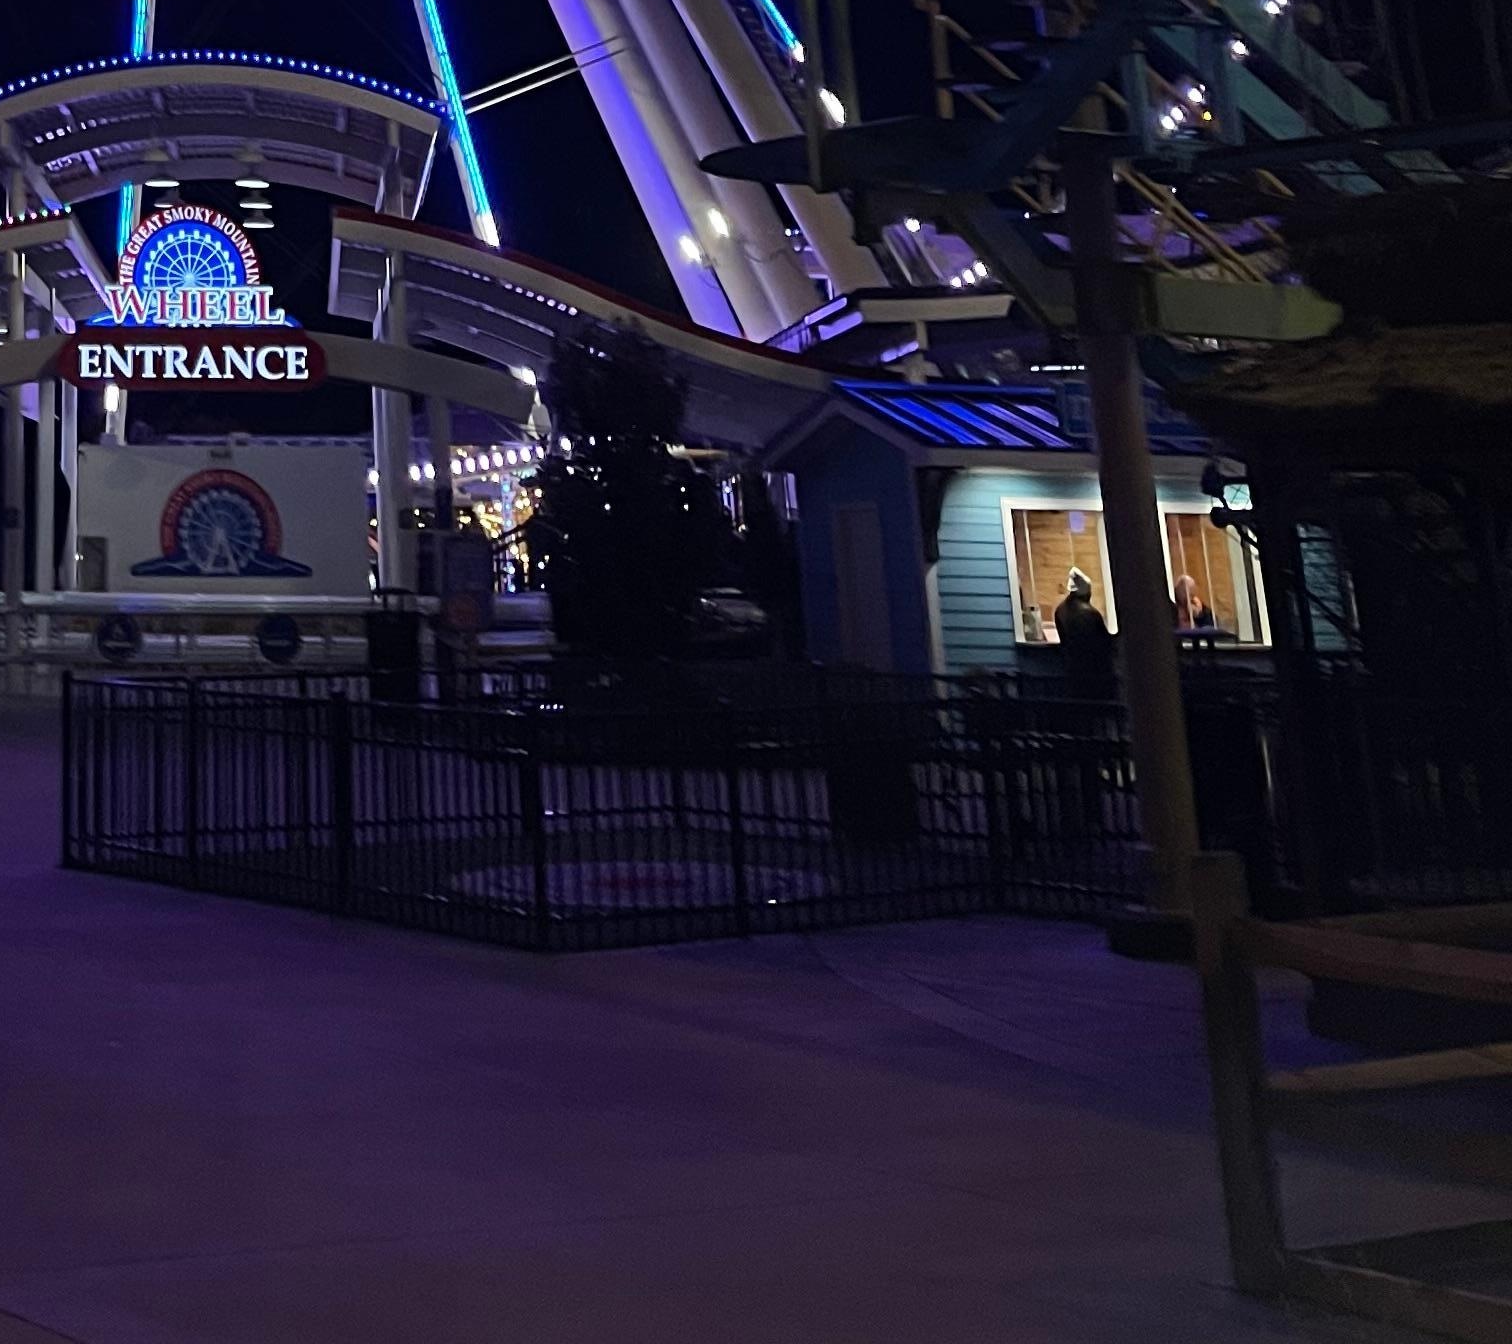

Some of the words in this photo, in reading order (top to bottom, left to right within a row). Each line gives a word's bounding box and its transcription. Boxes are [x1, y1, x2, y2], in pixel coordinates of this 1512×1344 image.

[120, 255, 136, 285] THE
[128, 214, 164, 255] GREAT
[163, 206, 214, 224] SMOKY
[212, 213, 260, 285] MOUNTAIN
[105, 286, 286, 325] WHEEL
[78, 344, 309, 380] ENTRANCE
